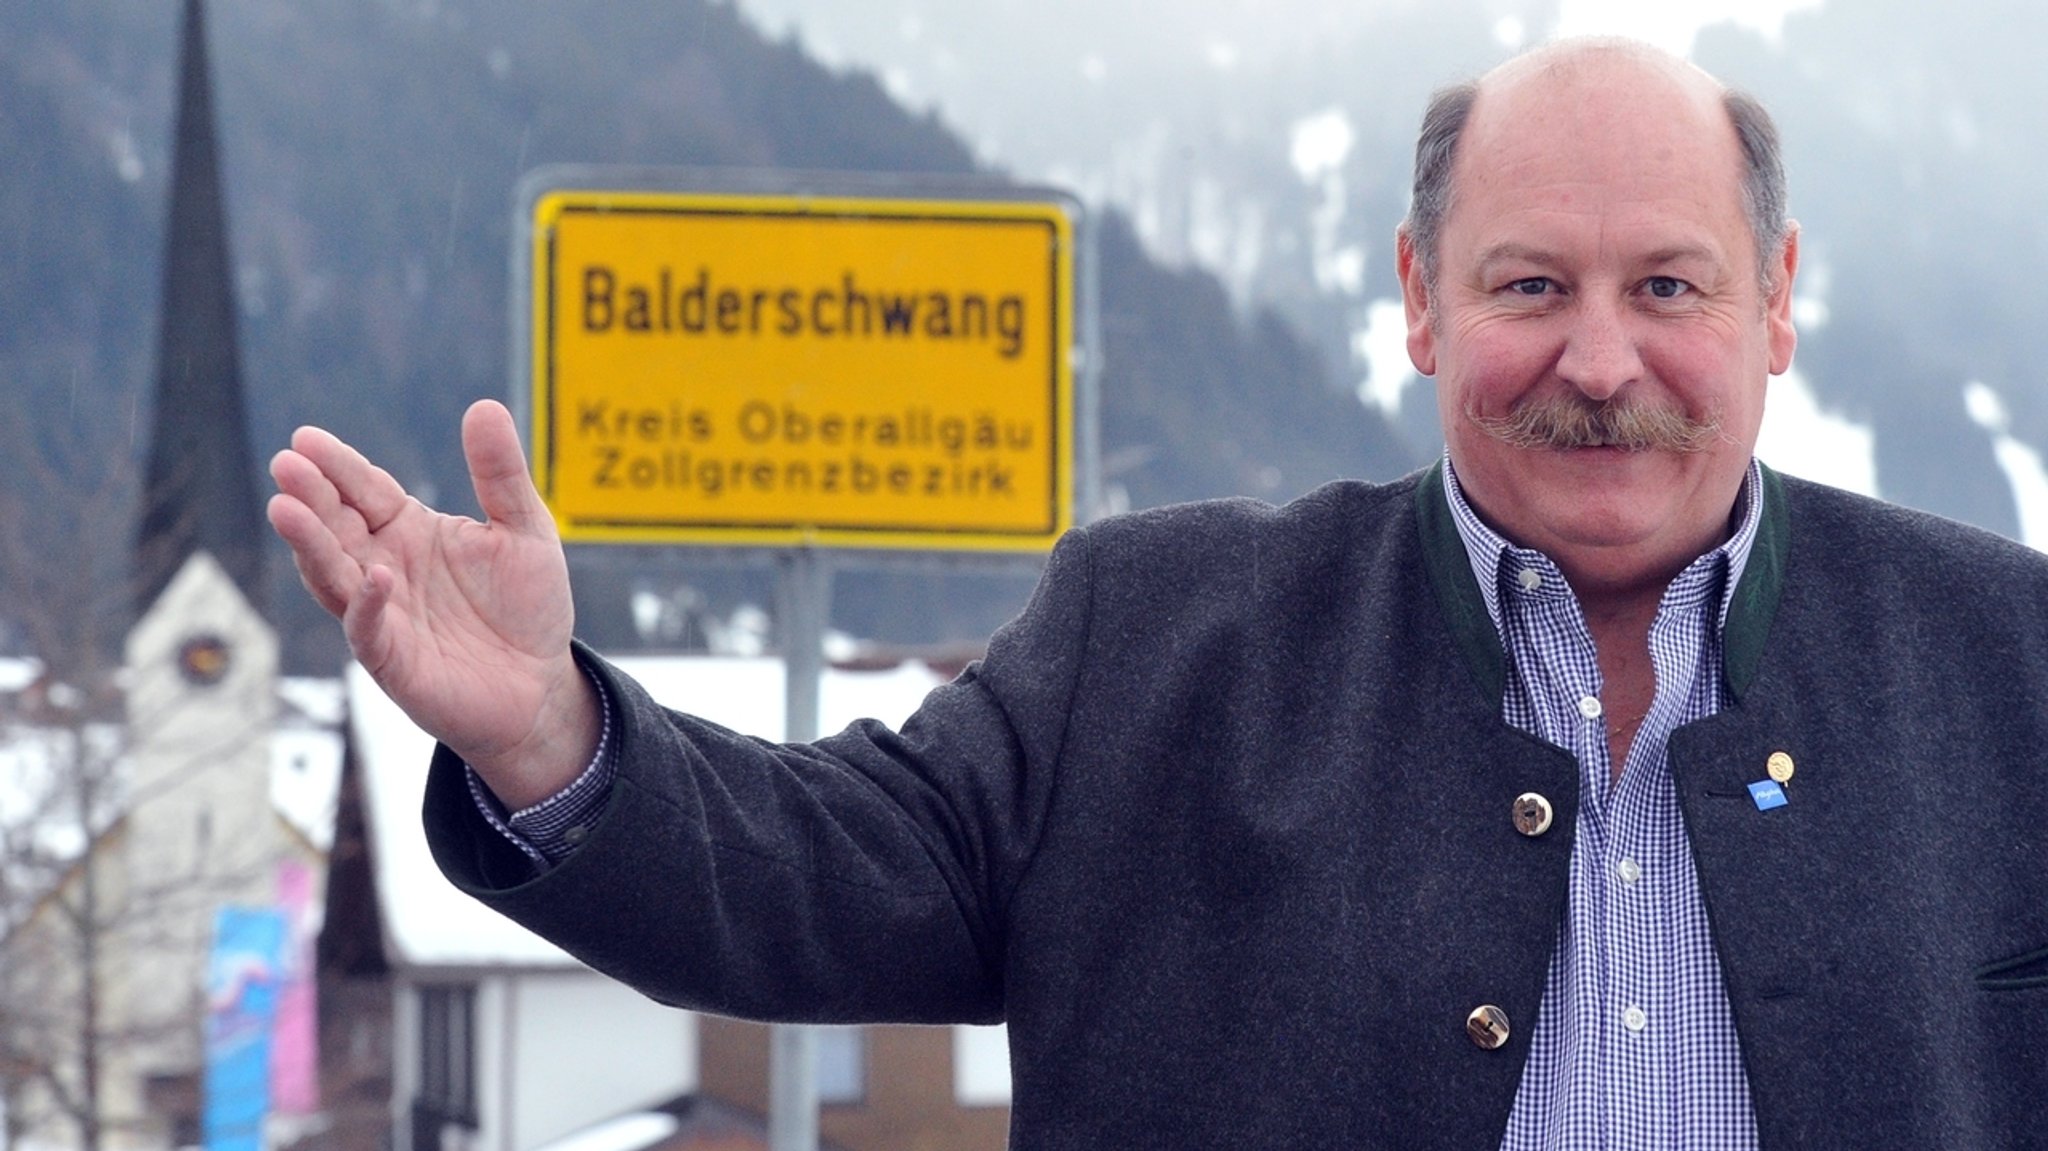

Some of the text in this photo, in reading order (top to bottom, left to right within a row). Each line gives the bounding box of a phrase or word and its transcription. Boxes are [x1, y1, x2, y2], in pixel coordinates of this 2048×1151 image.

[580, 266, 1026, 359] Balderschwang
[577, 398, 1034, 457] Kreis Oberallgäu
[592, 447, 1015, 497] Zollgrenzbezirk
